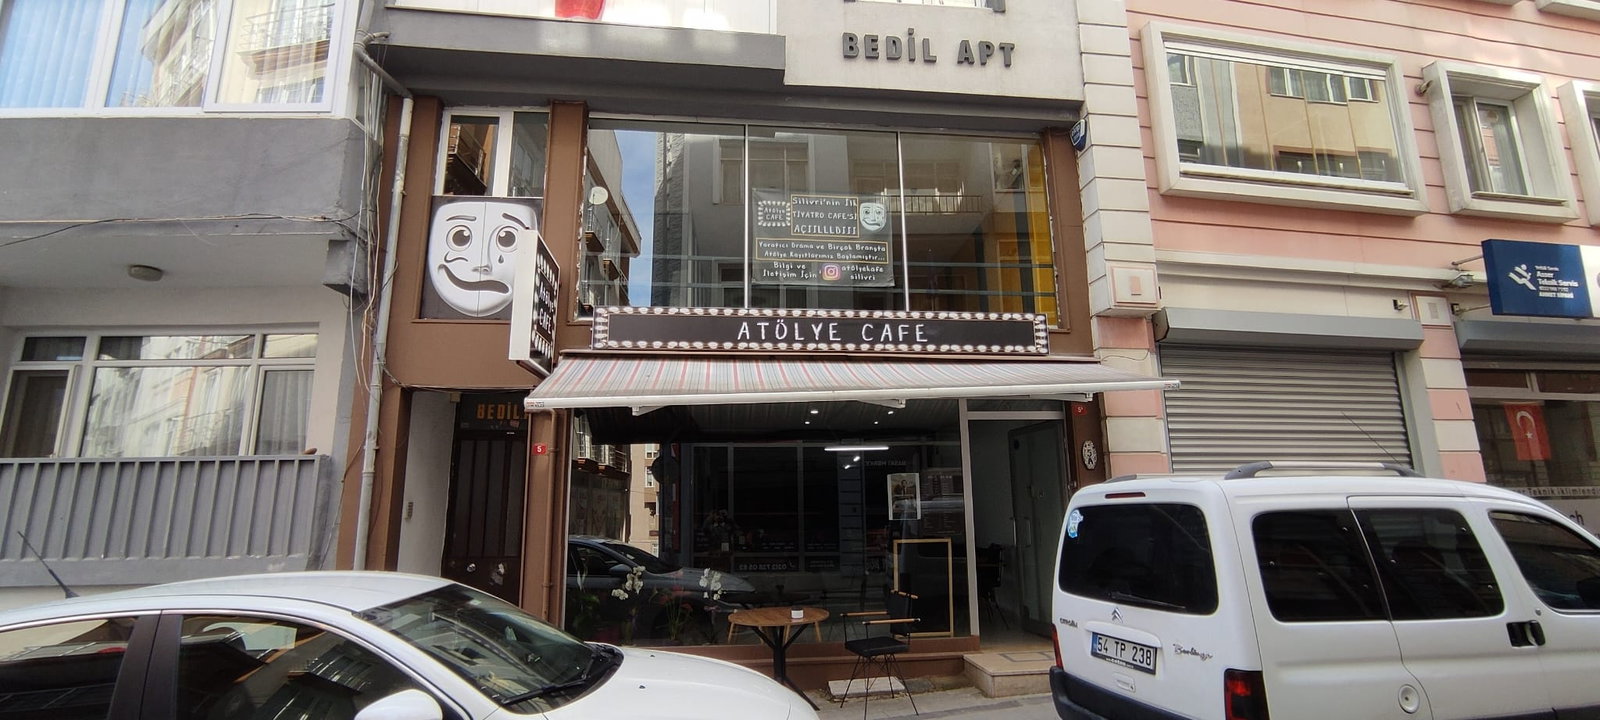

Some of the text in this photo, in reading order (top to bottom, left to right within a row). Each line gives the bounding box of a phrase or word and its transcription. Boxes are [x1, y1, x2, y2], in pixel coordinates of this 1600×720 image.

[842, 27, 1015, 67] BEDİL APT
[792, 197, 840, 206] Silivri'nin
[792, 210, 824, 219] TİYATRO
[827, 243, 852, 251] Birçok
[855, 243, 886, 252] Branşta
[764, 250, 788, 259] Atölye
[773, 261, 794, 270] Bilgi
[850, 273, 876, 281] silivri
[539, 308, 551, 334] CAFE
[737, 319, 928, 342] ATÖLYE CAFE
[476, 402, 520, 420] BEDİL
[1096, 636, 1109, 653] 54
[1114, 642, 1126, 657] TP
[1131, 646, 1152, 666] 238
